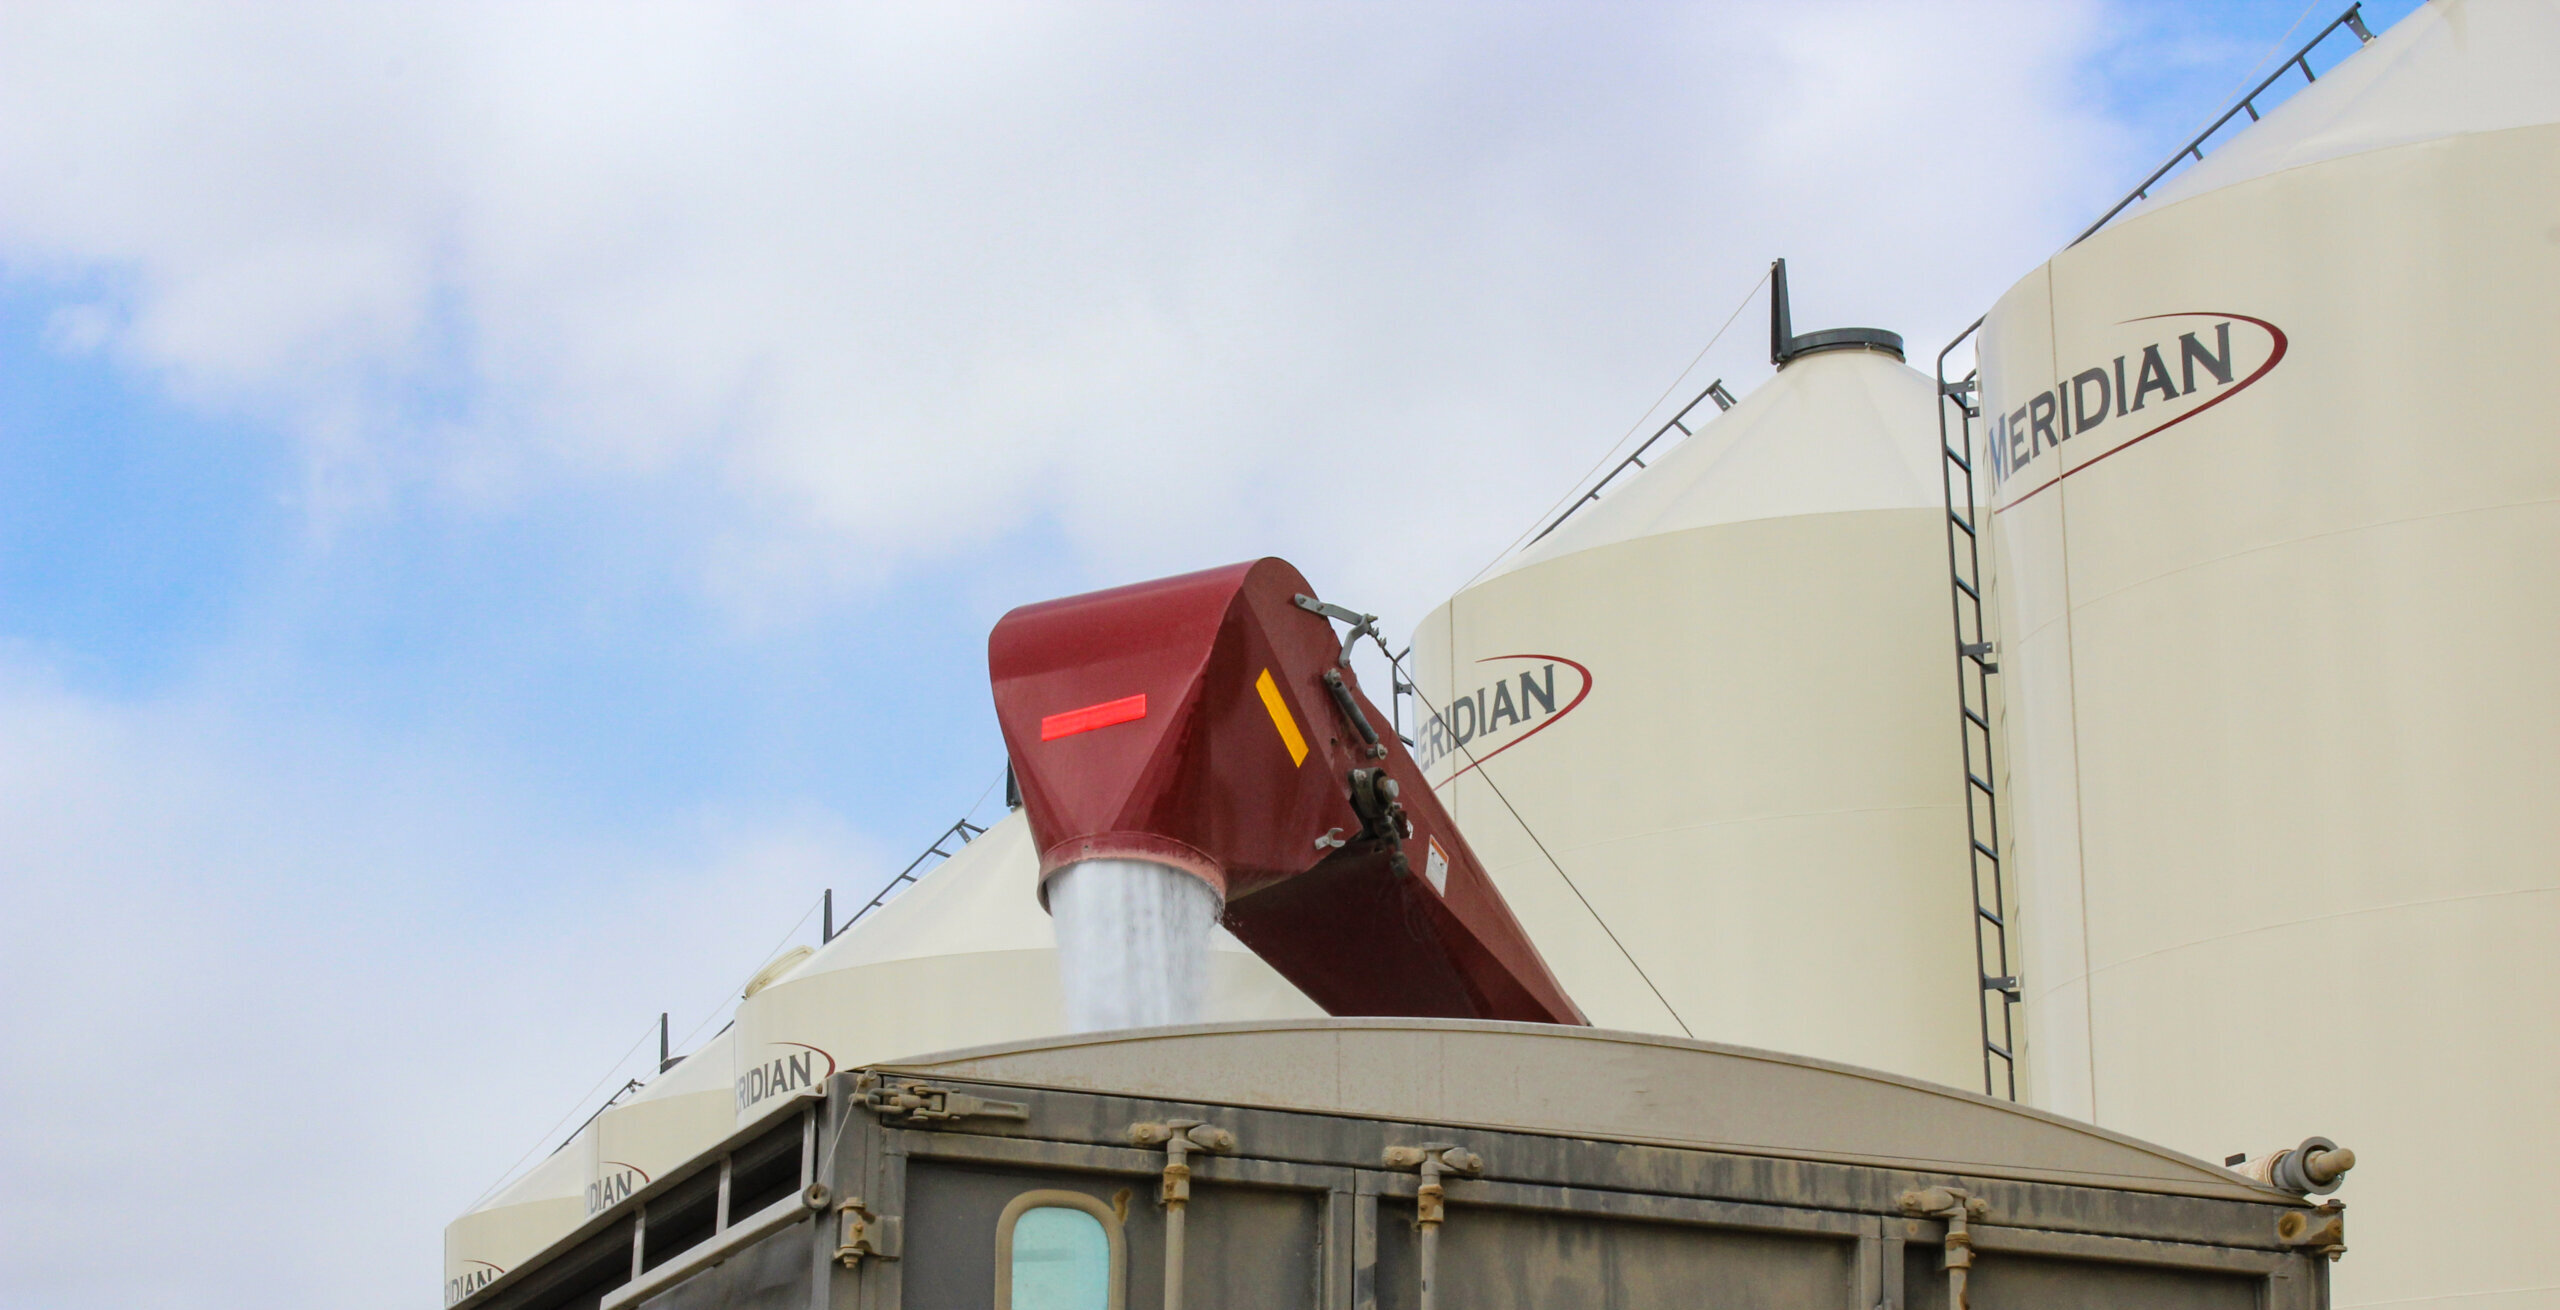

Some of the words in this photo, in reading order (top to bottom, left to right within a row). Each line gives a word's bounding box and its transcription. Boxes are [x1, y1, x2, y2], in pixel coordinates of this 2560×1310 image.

[1989, 322, 2234, 497] MERIDIAN
[1416, 664, 1556, 774] ERIDIAN
[737, 1051, 811, 1113] RIDIAN
